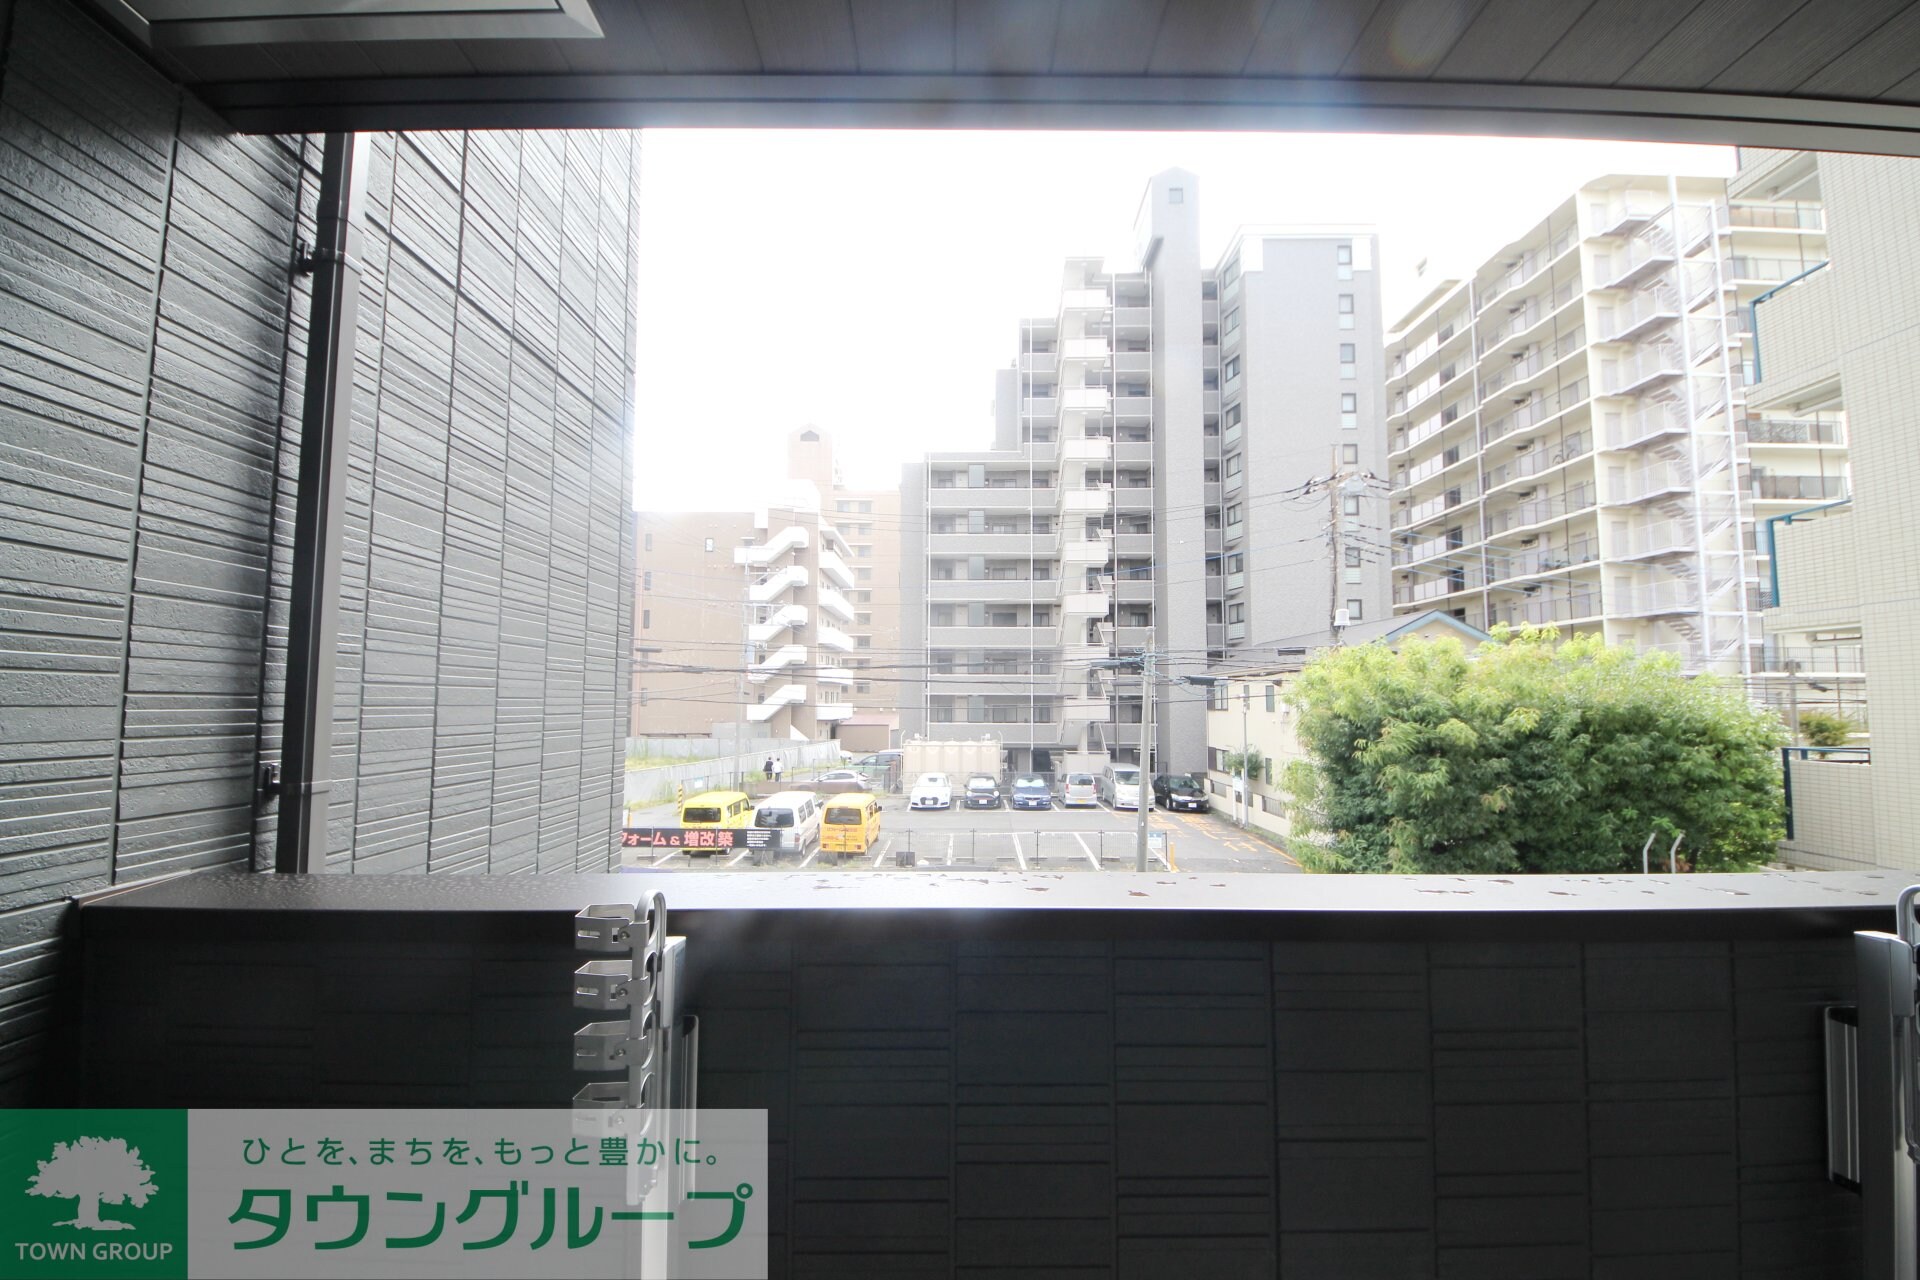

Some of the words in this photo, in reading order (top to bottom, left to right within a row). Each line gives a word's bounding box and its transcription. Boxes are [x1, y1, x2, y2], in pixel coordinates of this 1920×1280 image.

[669, 836, 681, 846] &
[684, 831, 734, 847] 増改築
